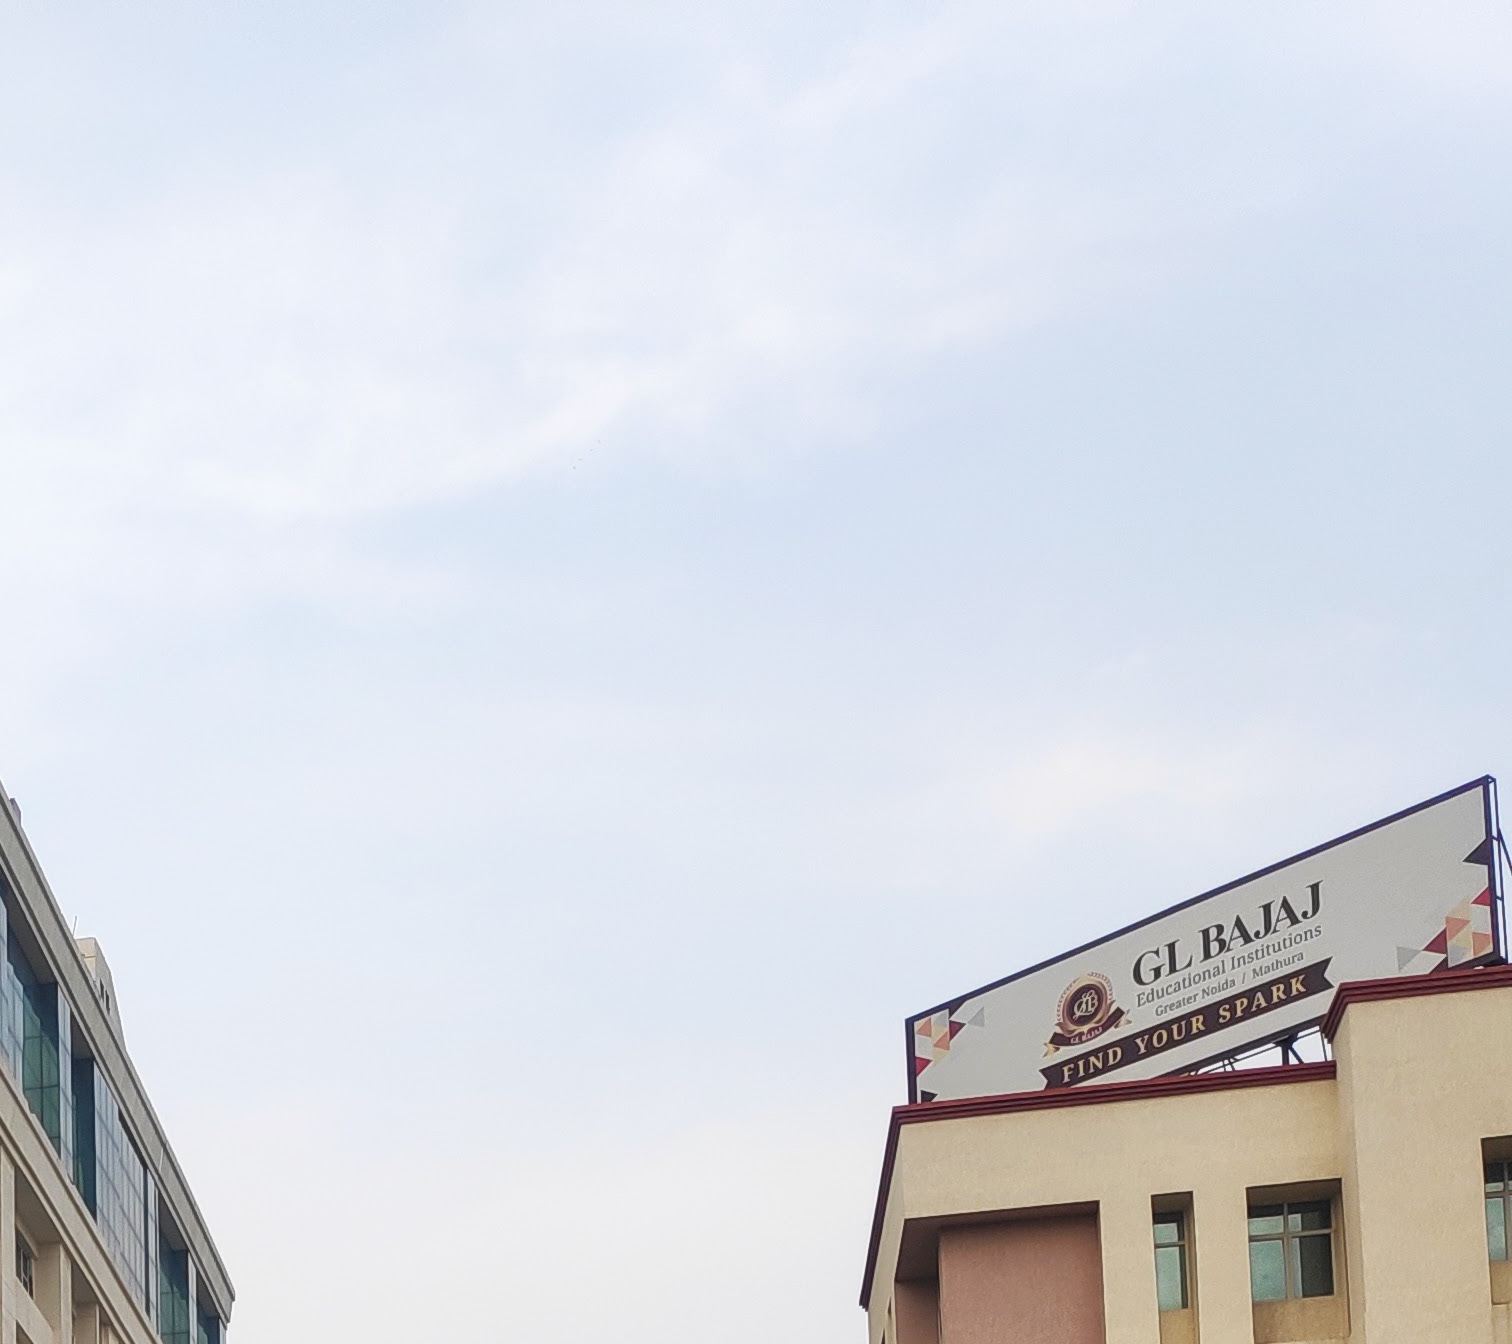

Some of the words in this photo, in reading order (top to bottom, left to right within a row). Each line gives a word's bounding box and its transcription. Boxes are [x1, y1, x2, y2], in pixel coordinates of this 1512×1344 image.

[1132, 939, 1193, 986] GL
[1198, 880, 1323, 963] BAJAJ
[1136, 960, 1226, 1008] Educational
[1230, 924, 1322, 971] Institutions
[1061, 1046, 1122, 1084] FIND
[1134, 1014, 1207, 1056] YOUR
[1218, 974, 1307, 1024] SPARK
[1155, 992, 1198, 1017] Greater
[1201, 978, 1236, 998] Noida
[1252, 951, 1304, 980] Mathura
